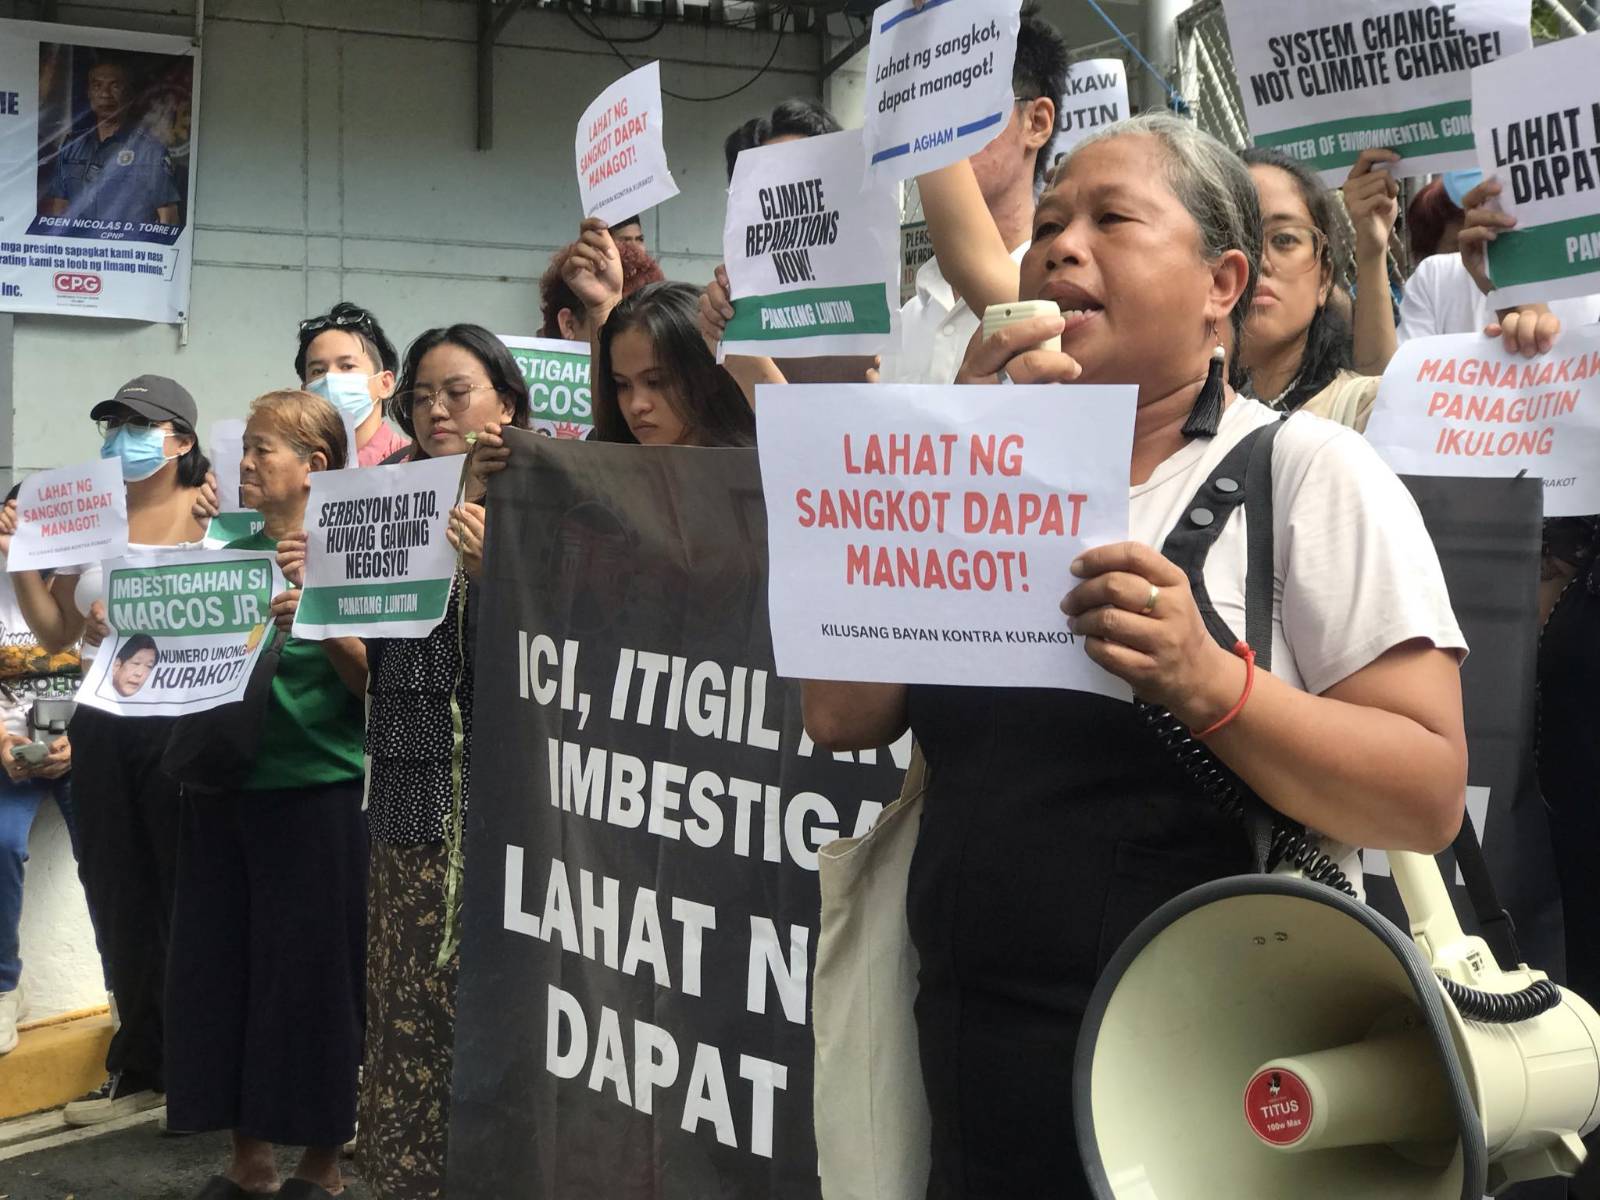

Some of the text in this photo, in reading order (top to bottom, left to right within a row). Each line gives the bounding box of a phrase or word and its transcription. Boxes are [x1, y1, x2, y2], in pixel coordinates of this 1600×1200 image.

[875, 20, 1000, 84] Lahat ng sangkot,
[1268, 4, 1466, 68] SYSTEM CHANGE,
[878, 52, 993, 113] dapat managot!
[1250, 31, 1501, 106] NOT CLIMATE CHANGE!
[588, 97, 629, 143] LAHAT NG
[1491, 107, 1580, 168] LAHAT
[580, 111, 649, 176] SANGKOT DAPAT
[913, 127, 954, 153] AGHAM
[1319, 135, 1336, 156] OF
[588, 145, 638, 191] MANAGOT!
[759, 178, 825, 221] CLIMATE
[38, 216, 70, 227] PGEN
[72, 218, 121, 230] NICOLAS
[123, 222, 134, 231] D.
[139, 223, 170, 235] TORRE
[746, 211, 840, 257] REPARATIONS
[905, 229, 933, 249] PLEAS
[54, 258, 65, 269] sa
[67, 259, 88, 270] loob
[90, 261, 102, 272] ng
[772, 249, 816, 285] NOW!
[2, 282, 23, 297] Inc.
[761, 303, 815, 330] PANATANG
[529, 383, 592, 418] COS
[1427, 389, 1581, 423] PANAGUTIN
[844, 434, 1025, 476] LAHAT NG
[1436, 427, 1554, 457] IKULONG
[38, 478, 93, 501] LAHAT NG
[23, 493, 113, 523] SANGKOT DAPAT
[41, 513, 101, 537] MANAGOT!
[319, 490, 440, 527] SERBISYON SA TAO,
[796, 488, 1088, 536] SANGKOT DAPAT
[326, 519, 429, 554] HUWAG GAWING
[346, 550, 409, 579] NEGOSYO!
[847, 544, 1029, 592] MANAGOT!
[113, 568, 267, 600] IMBESTIGAHAN SI
[113, 594, 267, 632] MARCOS JR.
[338, 593, 418, 616] PANATANG LUNTIAN
[821, 623, 1076, 645] KILUSANG BAYAN KONTRA KURAKOT
[158, 644, 248, 664] NUMERO UNONG
[151, 659, 246, 690] KURAKOT!
[518, 630, 591, 730] ICI,
[610, 648, 781, 750] ITIGIL
[504, 844, 716, 998] LAHAT
[546, 984, 788, 1159] DAPAT
[1260, 1099, 1299, 1119] TITUS
